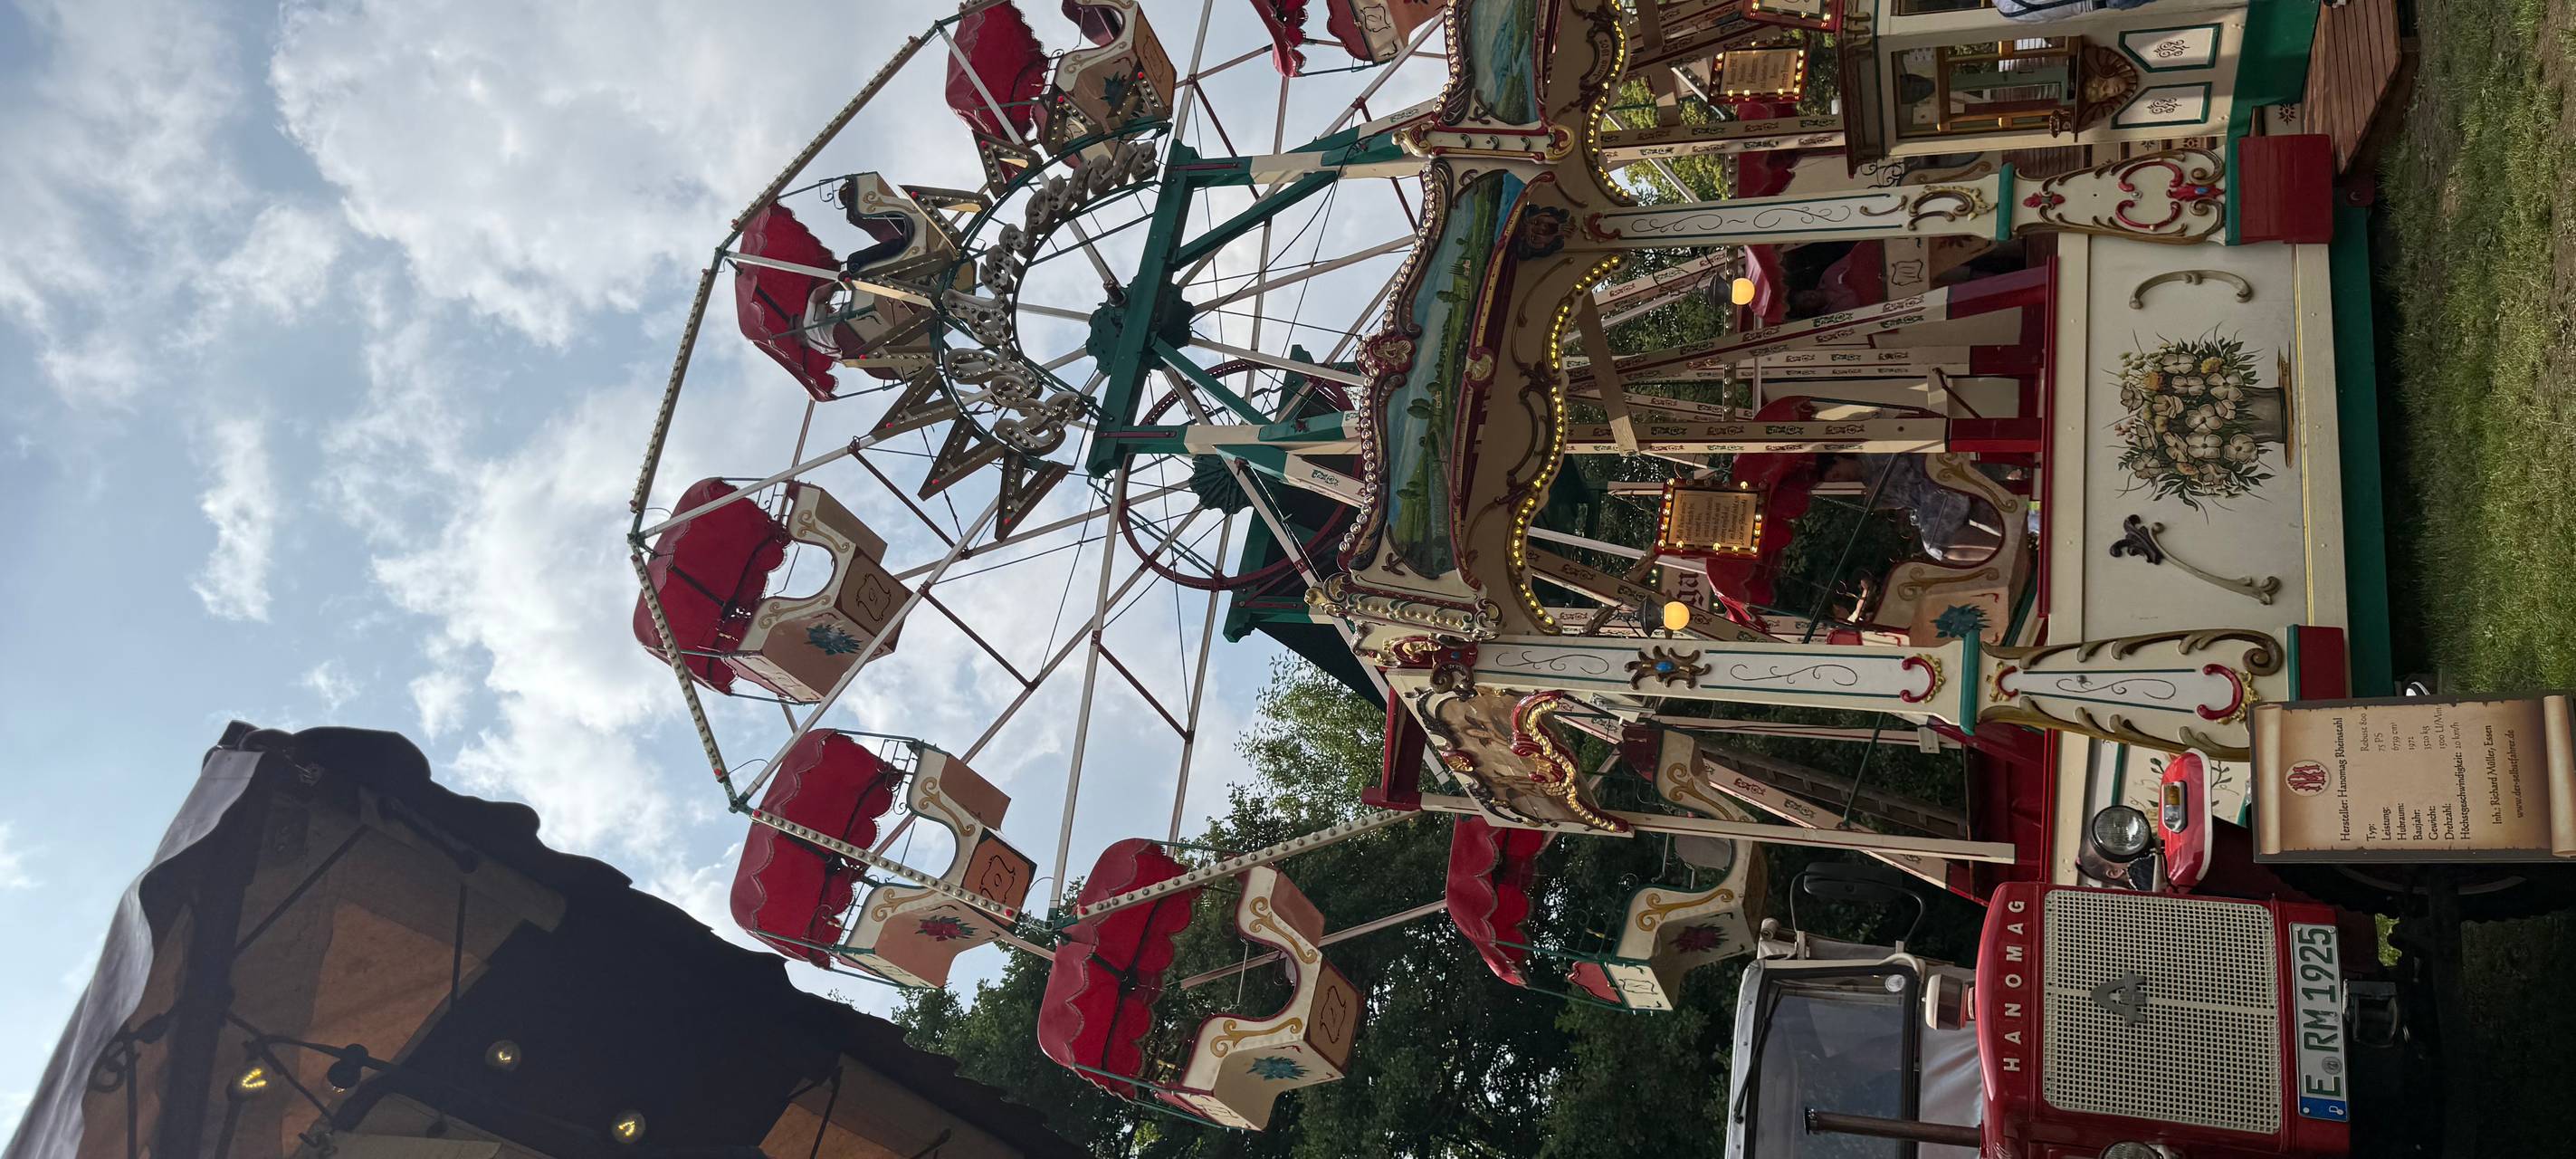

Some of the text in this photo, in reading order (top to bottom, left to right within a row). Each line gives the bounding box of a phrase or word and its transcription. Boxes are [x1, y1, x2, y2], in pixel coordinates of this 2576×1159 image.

[2360, 726, 2369, 752] Robust
[2375, 733, 2383, 742] PS
[2421, 725, 2430, 734] kg
[2439, 734, 2447, 750] 1500
[2450, 722, 2460, 740] km/h
[2333, 717, 2351, 841] Hersteller: Hanomag Rheinstahl
[2485, 725, 2502, 825] Inh.: Richard Müller, Essen
[2505, 730, 2524, 818] www.der-selbstfahrer.de
[2455, 752, 2470, 839] Höchstgeschwindigkeit:
[2366, 824, 2376, 841] Typ:
[2381, 807, 2391, 840] Leistung:
[2397, 803, 2407, 840] Hubraum:
[2412, 809, 2423, 840] Baujahr:
[2428, 806, 2438, 840] Gewicht:
[2443, 803, 2454, 840] Drehzahl:
[2297, 928, 2336, 1002] 1925
[2003, 900, 2025, 1072] HANOMAG
[2303, 1009, 2339, 1051] RM
[2306, 1075, 2341, 1097] E
